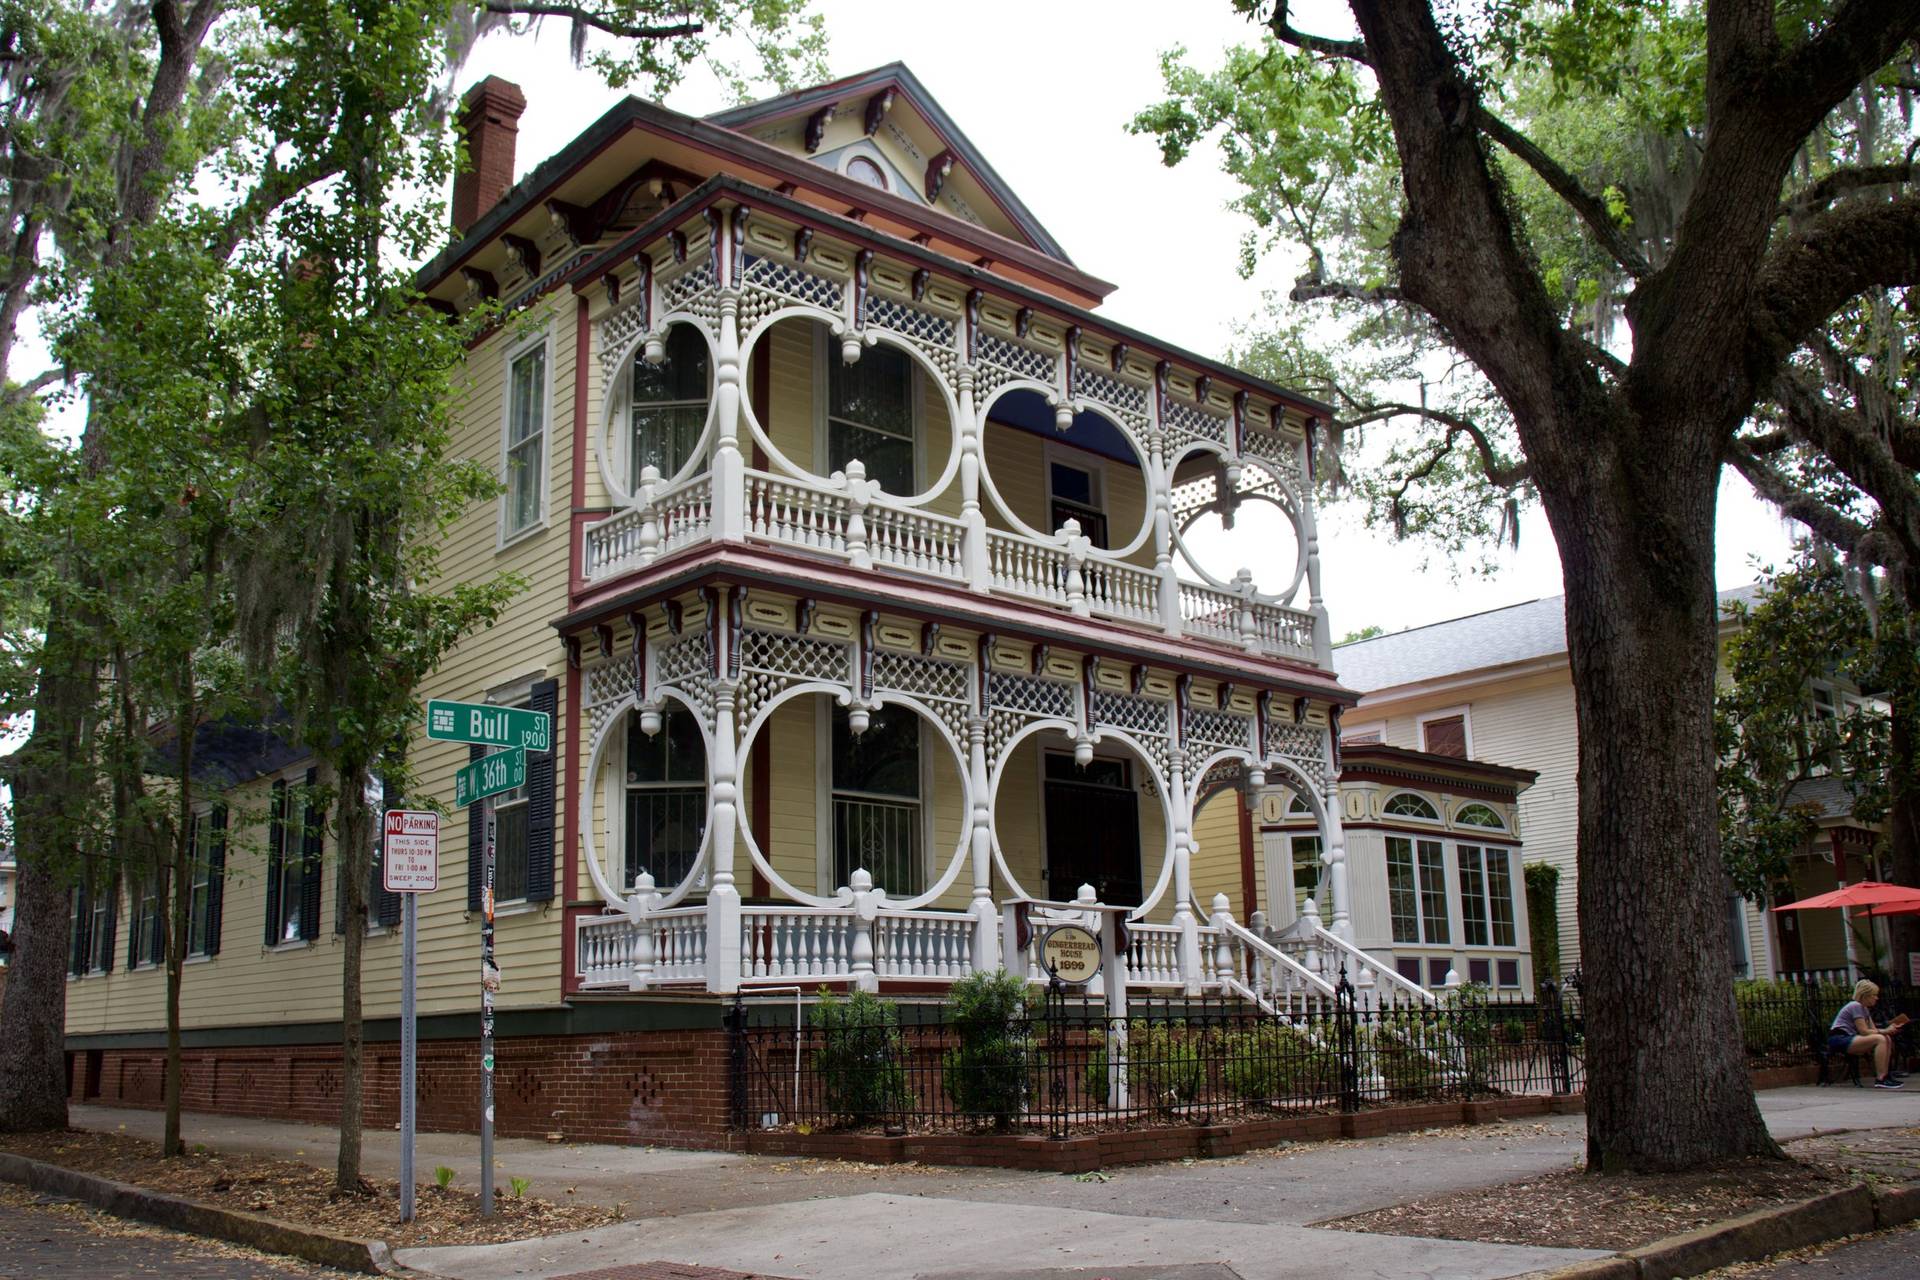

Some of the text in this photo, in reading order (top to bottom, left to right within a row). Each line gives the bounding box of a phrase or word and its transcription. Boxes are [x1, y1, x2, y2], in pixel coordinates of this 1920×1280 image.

[470, 709, 509, 741] Bull
[521, 730, 546, 746] 1900
[482, 757, 507, 791] 36th
[387, 815, 436, 832] NO PARKING
[391, 847, 408, 855] THURS
[408, 856, 415, 864] TO
[395, 863, 404, 871] FRI
[1047, 940, 1096, 951] GINGERBREAD
[1060, 949, 1083, 959] HOUSE
[1059, 960, 1085, 970] 1899
